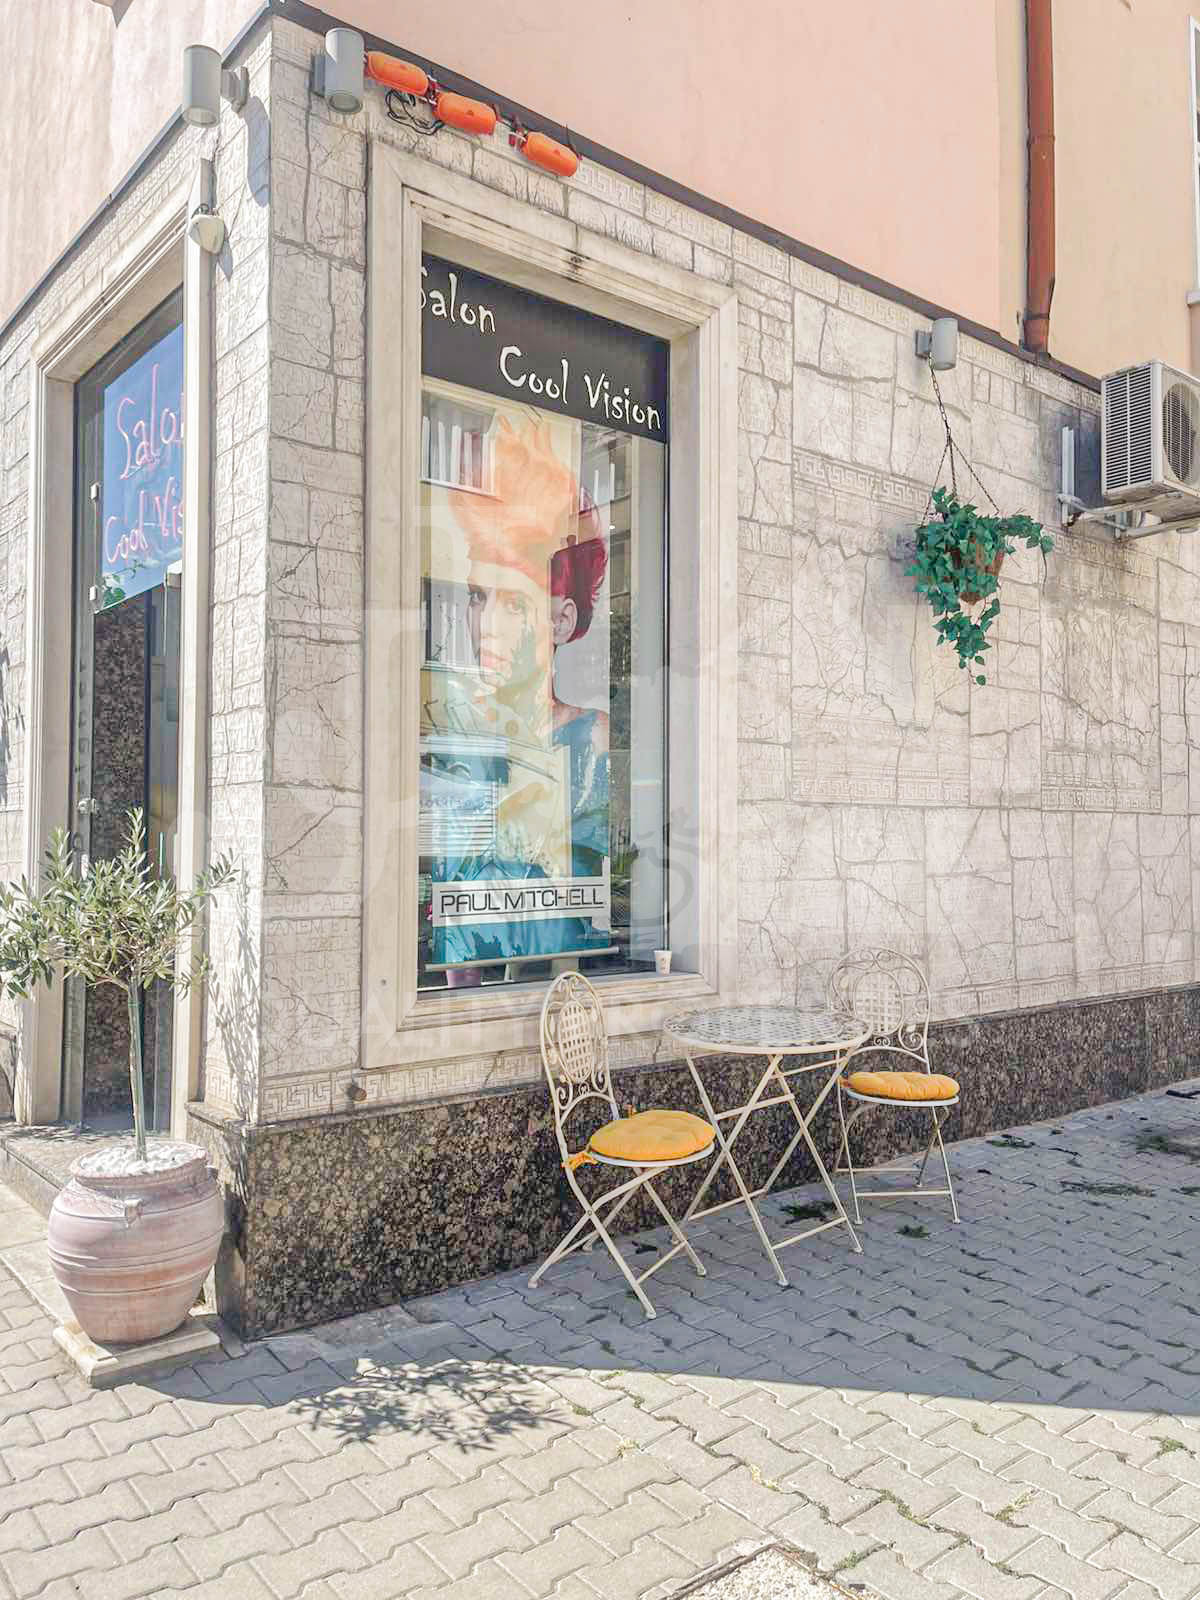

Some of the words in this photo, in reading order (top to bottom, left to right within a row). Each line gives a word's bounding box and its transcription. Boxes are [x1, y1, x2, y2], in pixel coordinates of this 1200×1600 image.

[117, 363, 184, 480] Salo
[499, 345, 569, 404] Cool
[583, 373, 662, 429] Vision
[104, 489, 149, 564] Cool
[440, 889, 500, 914] PAUL
